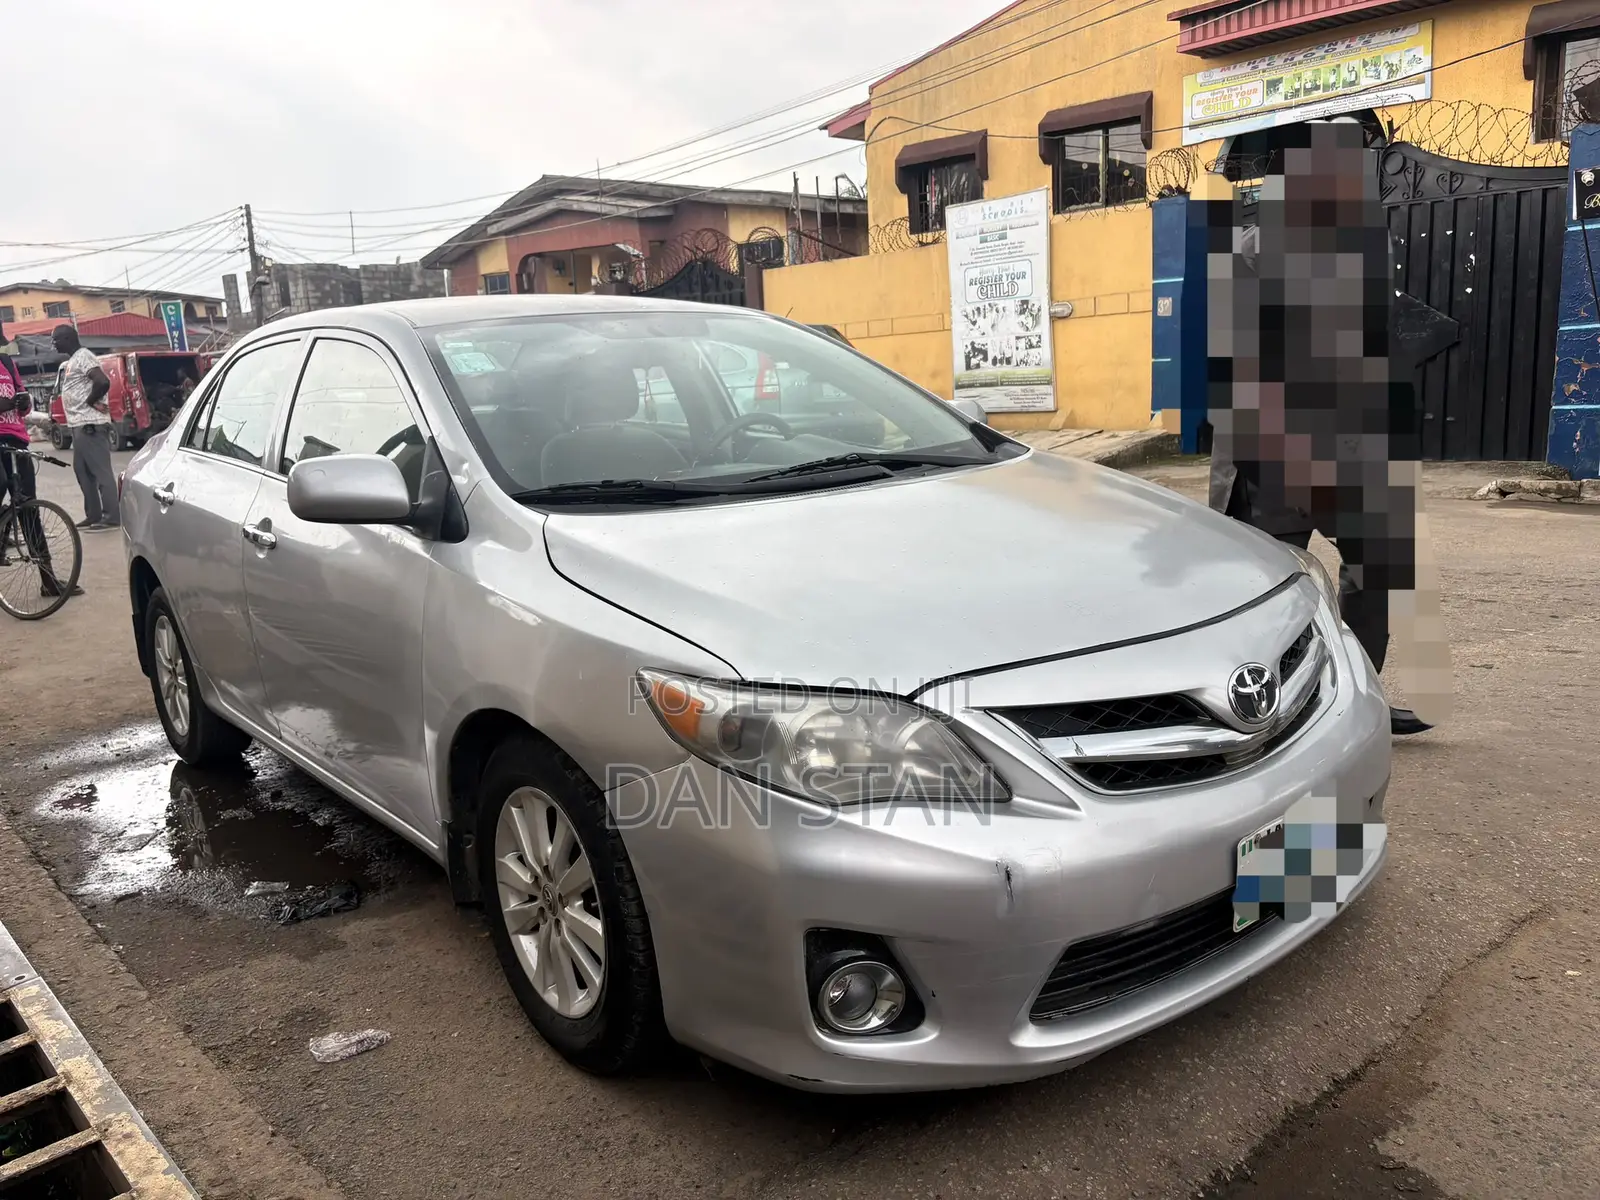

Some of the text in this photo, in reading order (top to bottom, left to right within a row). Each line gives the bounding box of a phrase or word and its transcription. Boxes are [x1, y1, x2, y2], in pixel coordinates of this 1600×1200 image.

[1250, 39, 1372, 71] SCHOOLS
[1196, 88, 1258, 106] REGISTER YOUR
[1202, 97, 1251, 115] CHILD
[969, 271, 1027, 286] REGISTER YOUR
[977, 281, 1019, 300] CHILD
